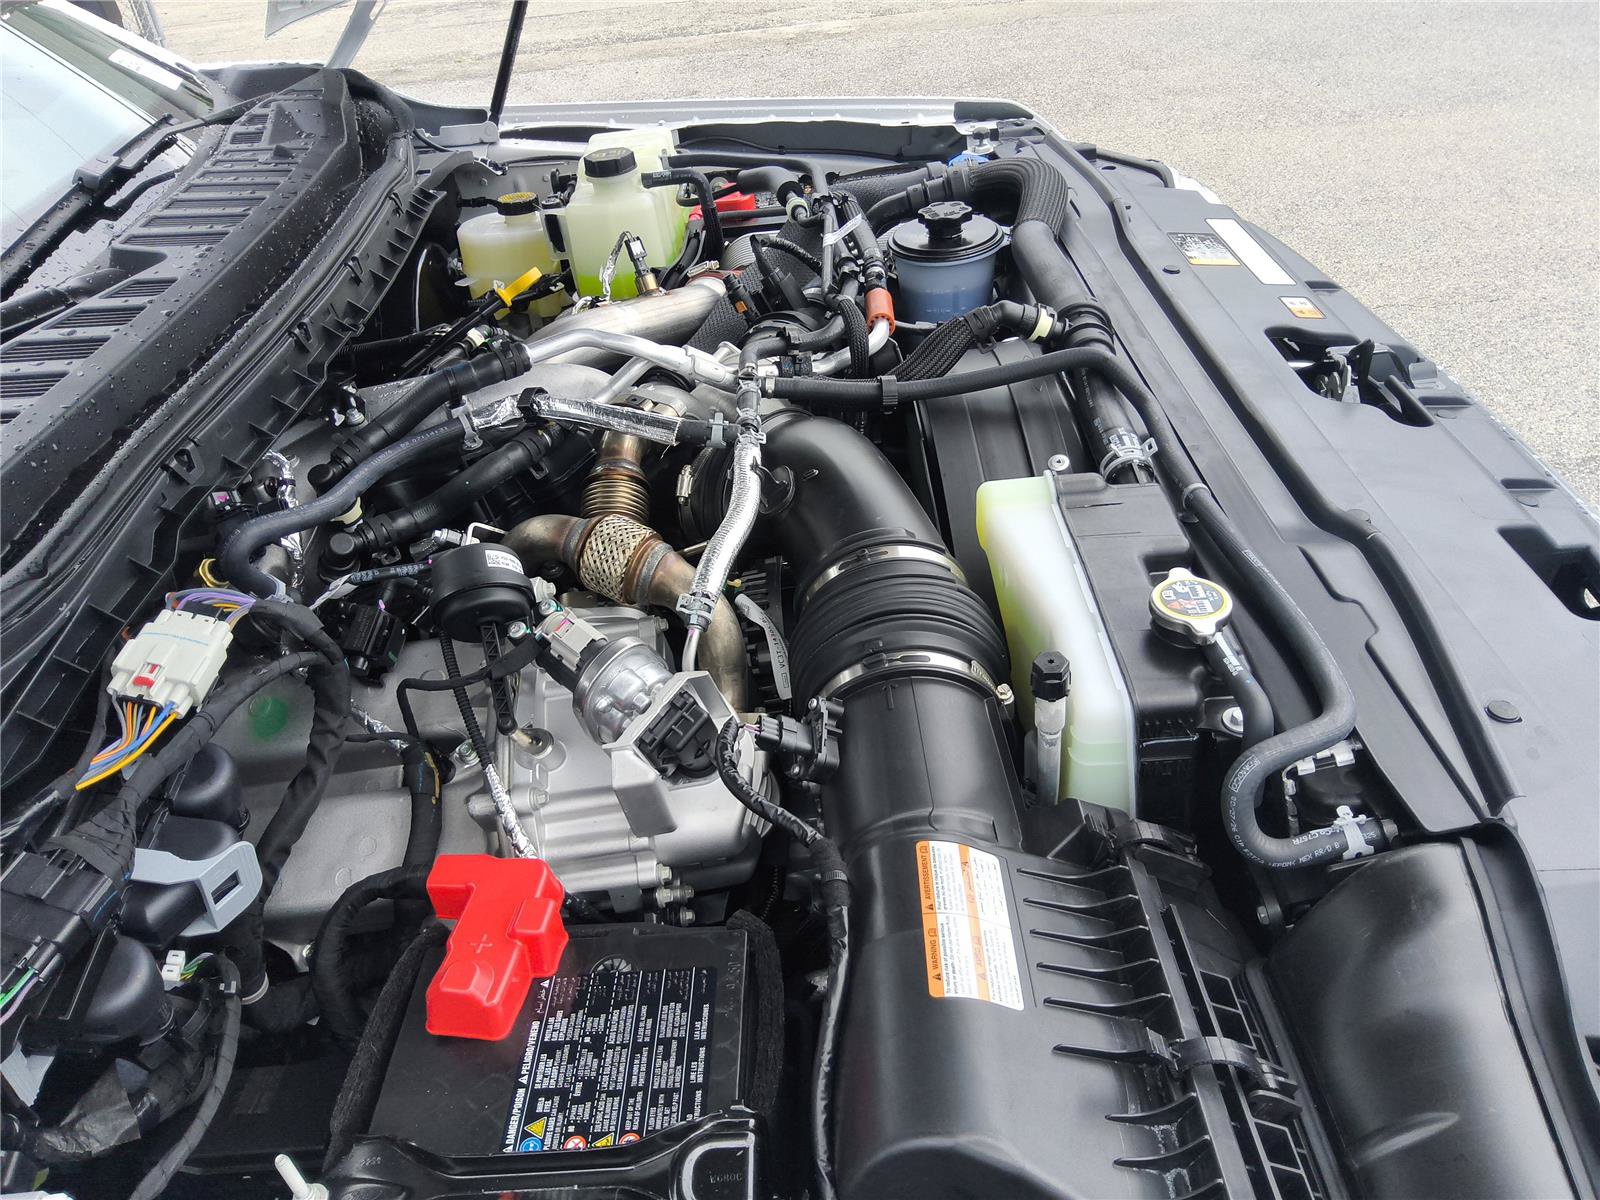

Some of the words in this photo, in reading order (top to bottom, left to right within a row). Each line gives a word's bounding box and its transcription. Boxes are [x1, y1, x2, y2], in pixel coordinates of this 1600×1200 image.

[920, 855, 931, 899] AVERTISSEMENT
[929, 938, 938, 970] WARNING
[521, 1020, 540, 1074] PELIGRO/VENENO
[535, 1097, 544, 1112] SHIELD
[569, 1104, 577, 1119] SPARKS
[576, 1104, 584, 1119] FLAMES
[583, 1101, 591, 1119] SMOKING
[597, 1100, 605, 1110] ACID
[604, 1097, 612, 1117] BLINDNESS
[693, 1089, 701, 1118] TRUCTIONS.
[505, 1088, 526, 1144] DANGER/POISON
[594, 1111, 603, 1131] SULFURIC
[624, 1120, 632, 1130] KEEP
[647, 1117, 655, 1129] FLUSH
[543, 1131, 553, 1150] PLOSIVE
